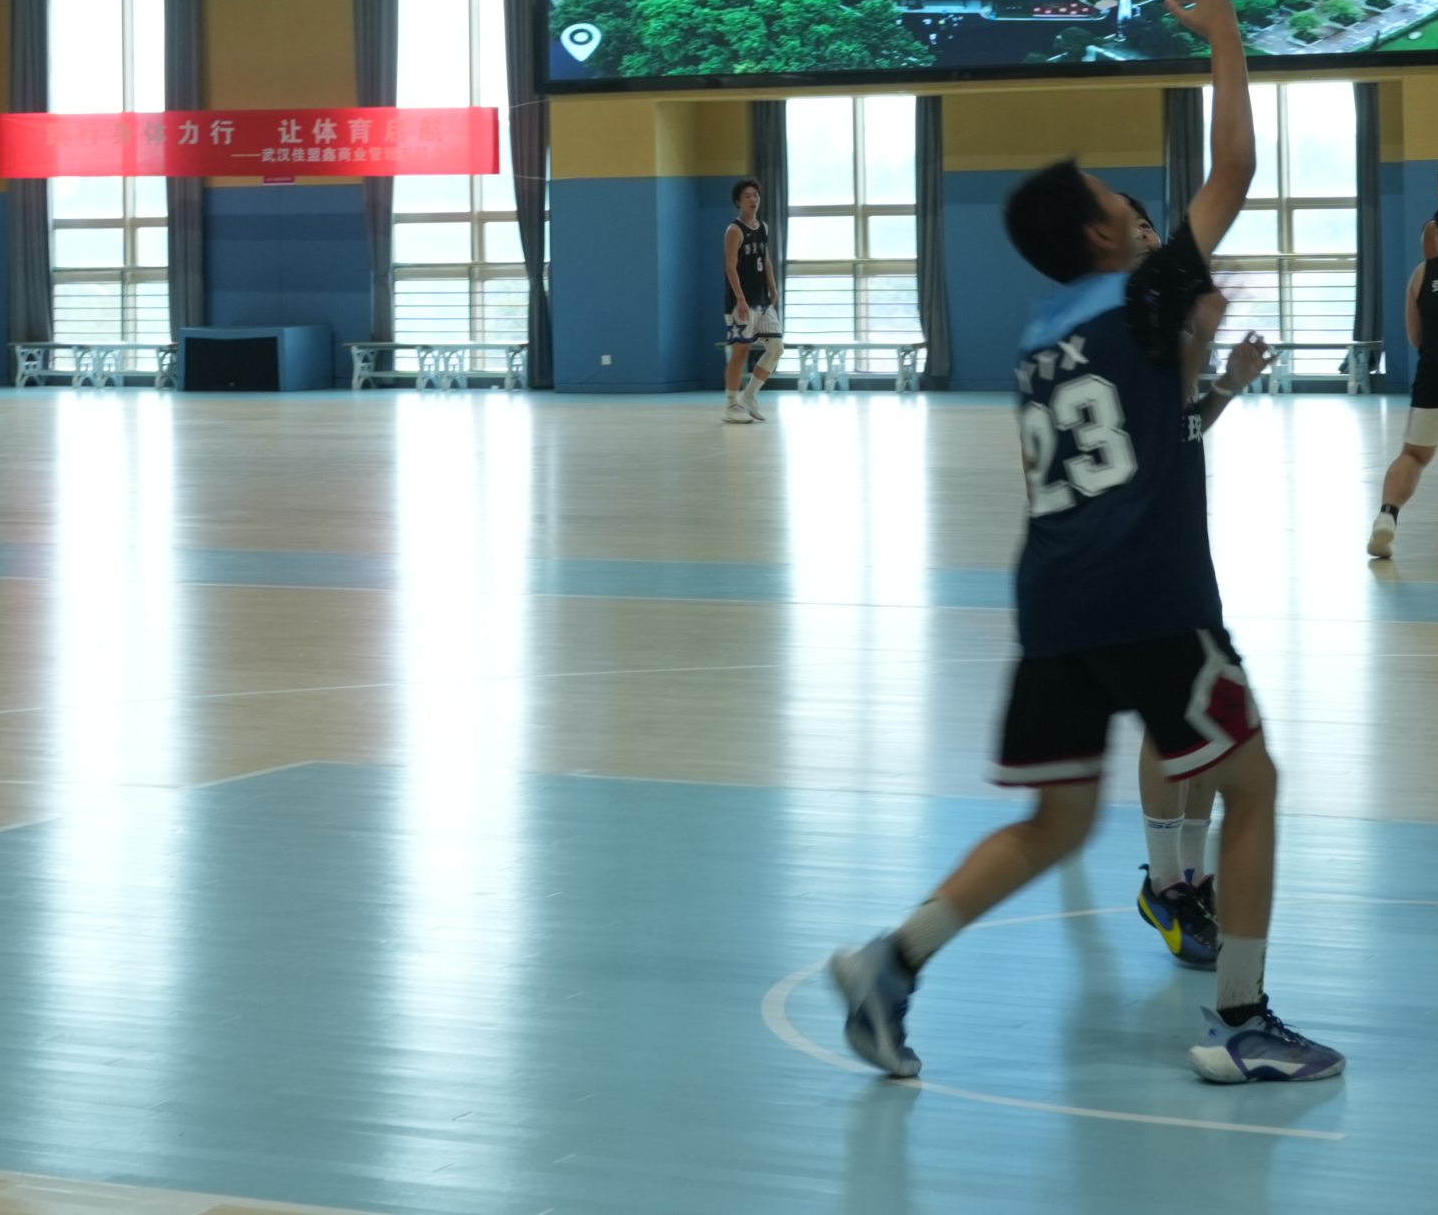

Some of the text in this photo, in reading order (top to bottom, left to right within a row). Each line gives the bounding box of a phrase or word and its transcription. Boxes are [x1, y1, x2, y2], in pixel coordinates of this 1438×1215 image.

[277, 118, 445, 144] 让体育启航
[756, 256, 763, 272] 6
[1020, 373, 1139, 518] 23
